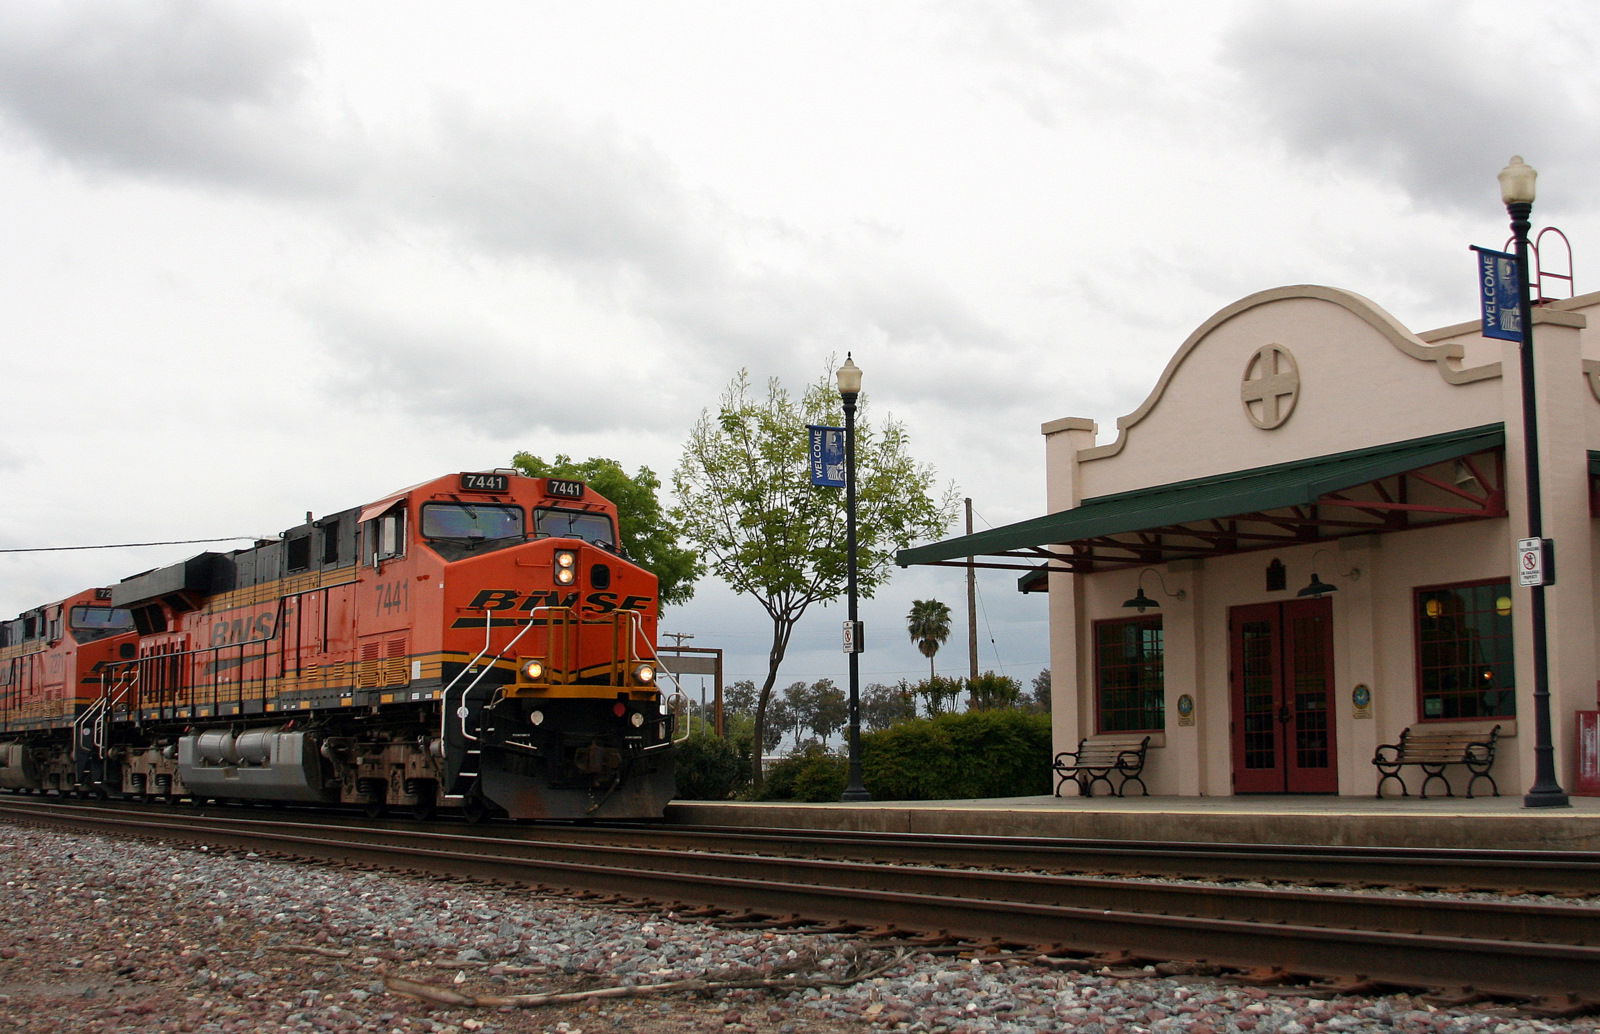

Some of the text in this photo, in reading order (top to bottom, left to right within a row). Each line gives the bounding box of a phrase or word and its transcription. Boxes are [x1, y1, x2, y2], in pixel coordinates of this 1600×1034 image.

[1484, 255, 1496, 327] WELCOME
[813, 430, 824, 479] WELCOME
[467, 475, 502, 489] 7441
[552, 481, 580, 496] 7441
[375, 578, 408, 616] 7441
[465, 589, 652, 614] BNSF
